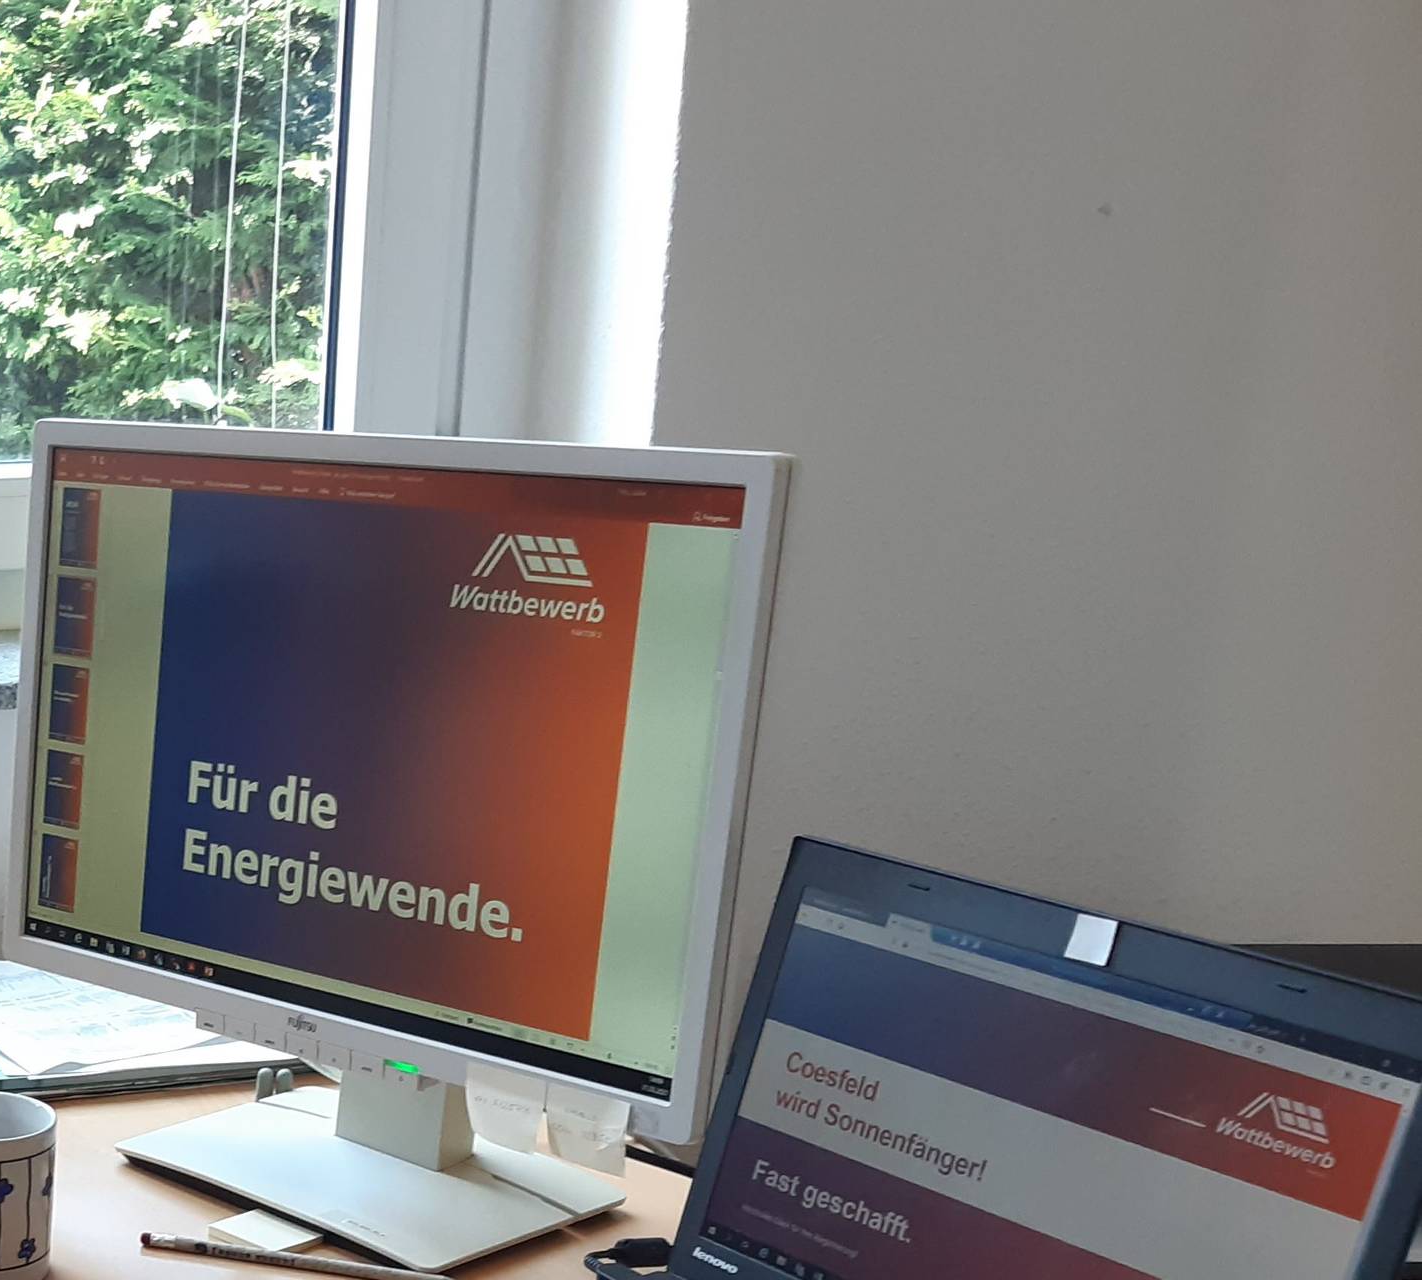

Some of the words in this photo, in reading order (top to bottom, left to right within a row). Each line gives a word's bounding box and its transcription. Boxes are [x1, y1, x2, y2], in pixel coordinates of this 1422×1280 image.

[449, 584, 605, 623] Wattbewerb
[187, 760, 259, 813] Für
[269, 775, 338, 830] die
[182, 828, 524, 942] Energiewende.
[287, 1014, 318, 1033] FUJITSU
[785, 1051, 880, 1102] Coesfeld
[775, 1090, 821, 1119] wird
[824, 1103, 988, 1181] Sonnenfänger!
[1215, 1117, 1336, 1169] Wattbewerb
[751, 1159, 800, 1197] Fast
[801, 1185, 911, 1244] geschafft.
[691, 1247, 739, 1274] lenovo
